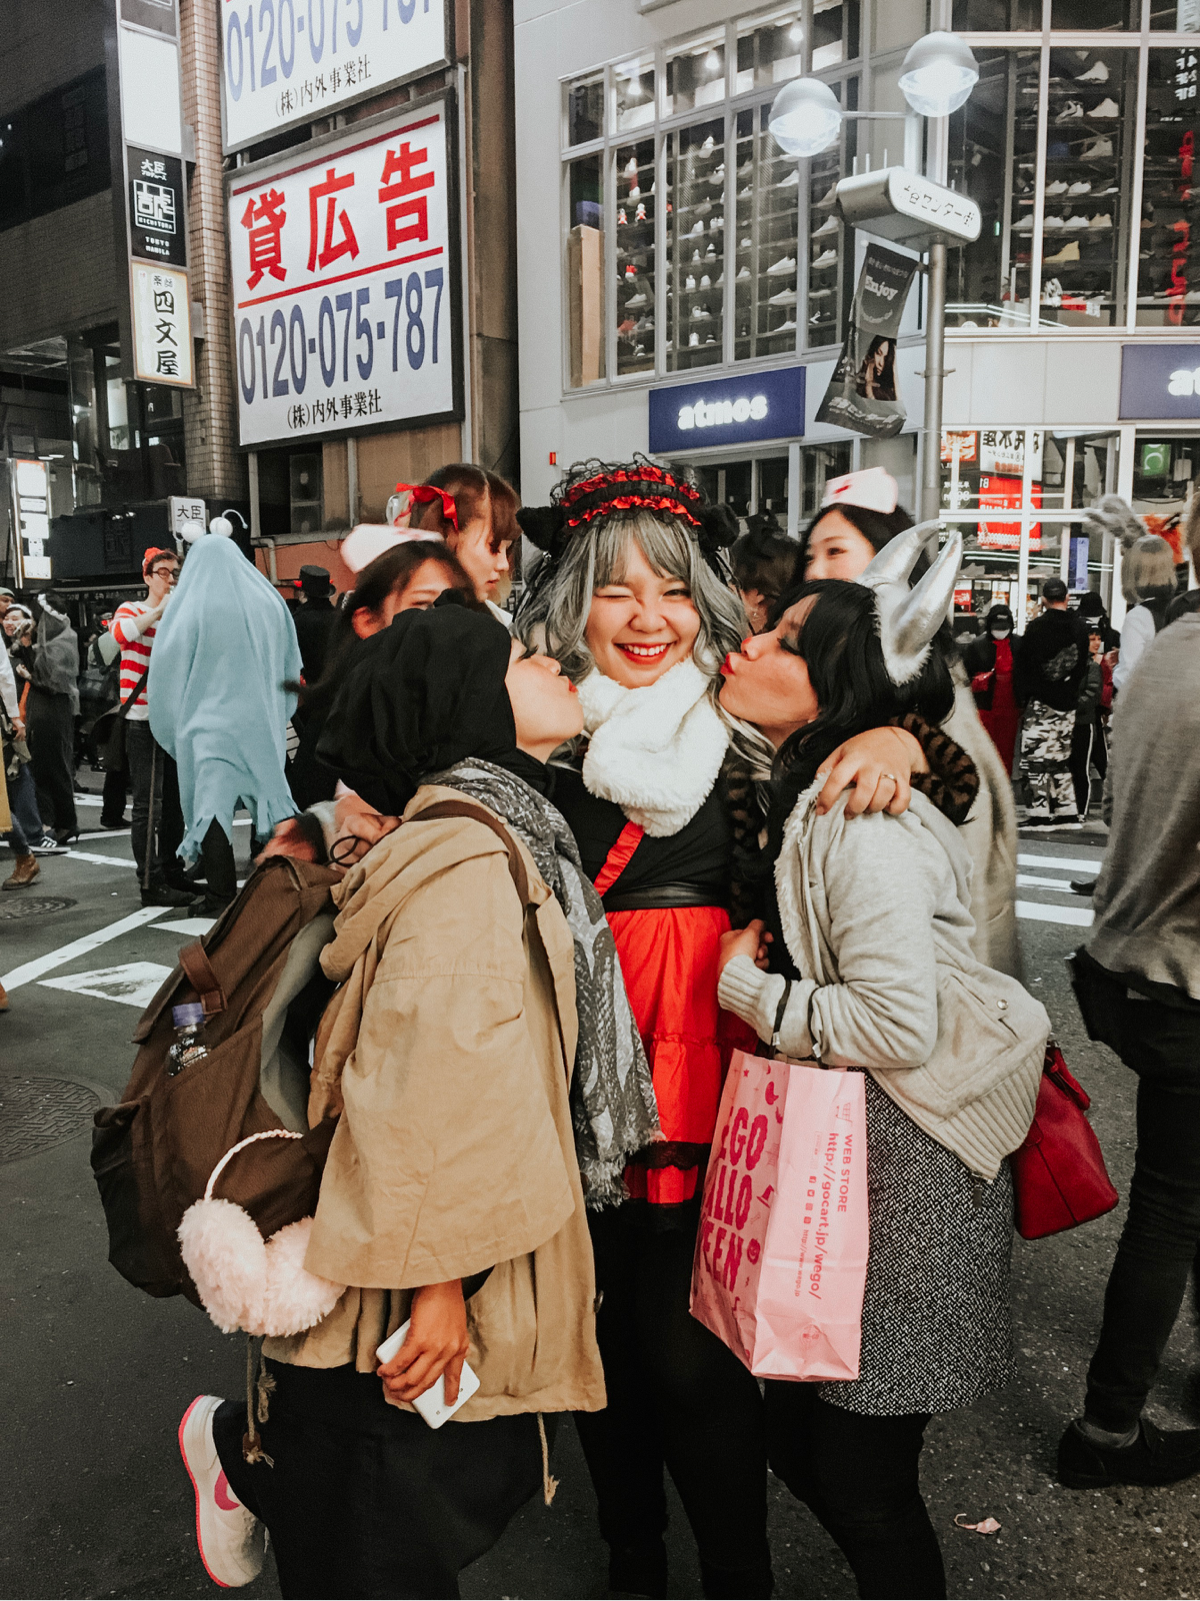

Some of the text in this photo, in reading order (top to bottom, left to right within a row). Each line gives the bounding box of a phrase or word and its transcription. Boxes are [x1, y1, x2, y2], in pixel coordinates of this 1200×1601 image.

[140, 159, 167, 176] 大臣
[240, 141, 435, 291] 貸広告
[145, 236, 170, 247] TOKYO
[145, 245, 170, 256] MANILA
[864, 275, 899, 301] Enjoy
[153, 289, 179, 376] 四文屋
[239, 266, 444, 405] 0120-075-787
[287, 388, 382, 429] (株)内外事業社
[678, 395, 768, 430] atmos
[177, 504, 204, 520] 大臣
[837, 1133, 853, 1213] WEB STORE
[808, 1132, 840, 1300] http://gocart.jp/wego/
